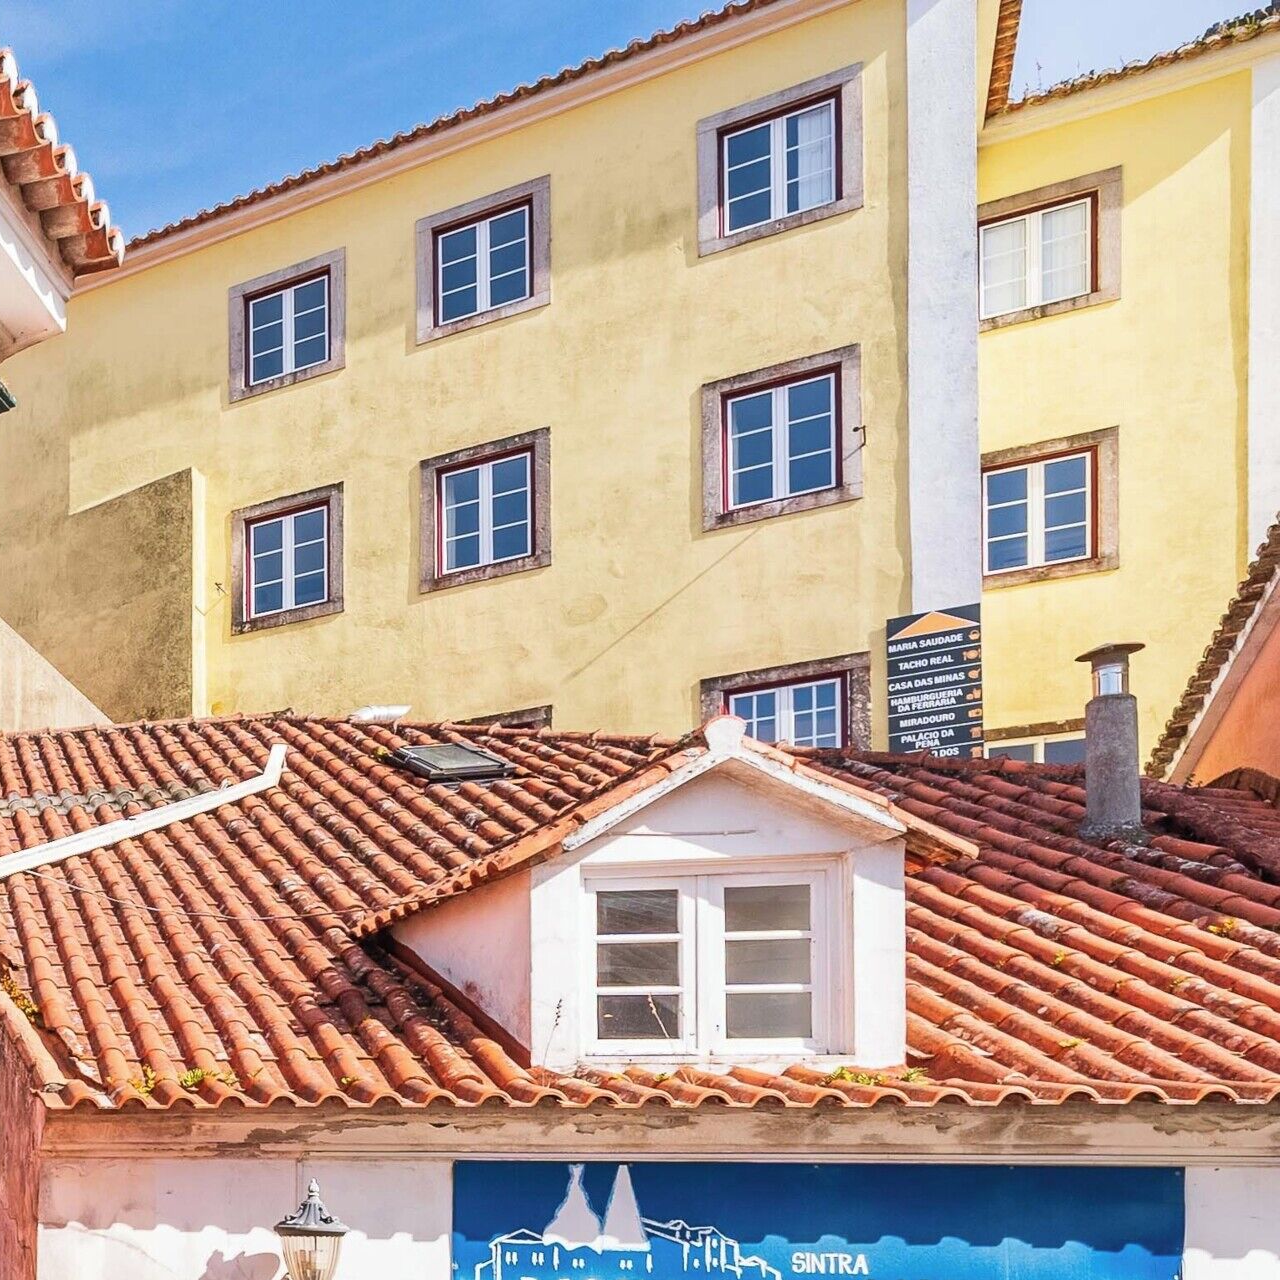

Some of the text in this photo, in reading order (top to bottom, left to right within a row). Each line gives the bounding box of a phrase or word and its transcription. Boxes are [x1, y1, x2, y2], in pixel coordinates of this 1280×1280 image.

[888, 633, 964, 653] MARIA SAUDADE
[898, 655, 954, 671] TACHO REAL
[888, 672, 965, 692] CASA DAS MINAS
[891, 688, 963, 706] HAMBURGUERIA
[897, 697, 956, 713] DA FERRARIA
[899, 713, 956, 728] MIRADOURO
[941, 728, 954, 738] DA
[915, 739, 940, 749] PENA
[940, 747, 960, 757] DOS
[791, 1252, 869, 1275] SINTRA
